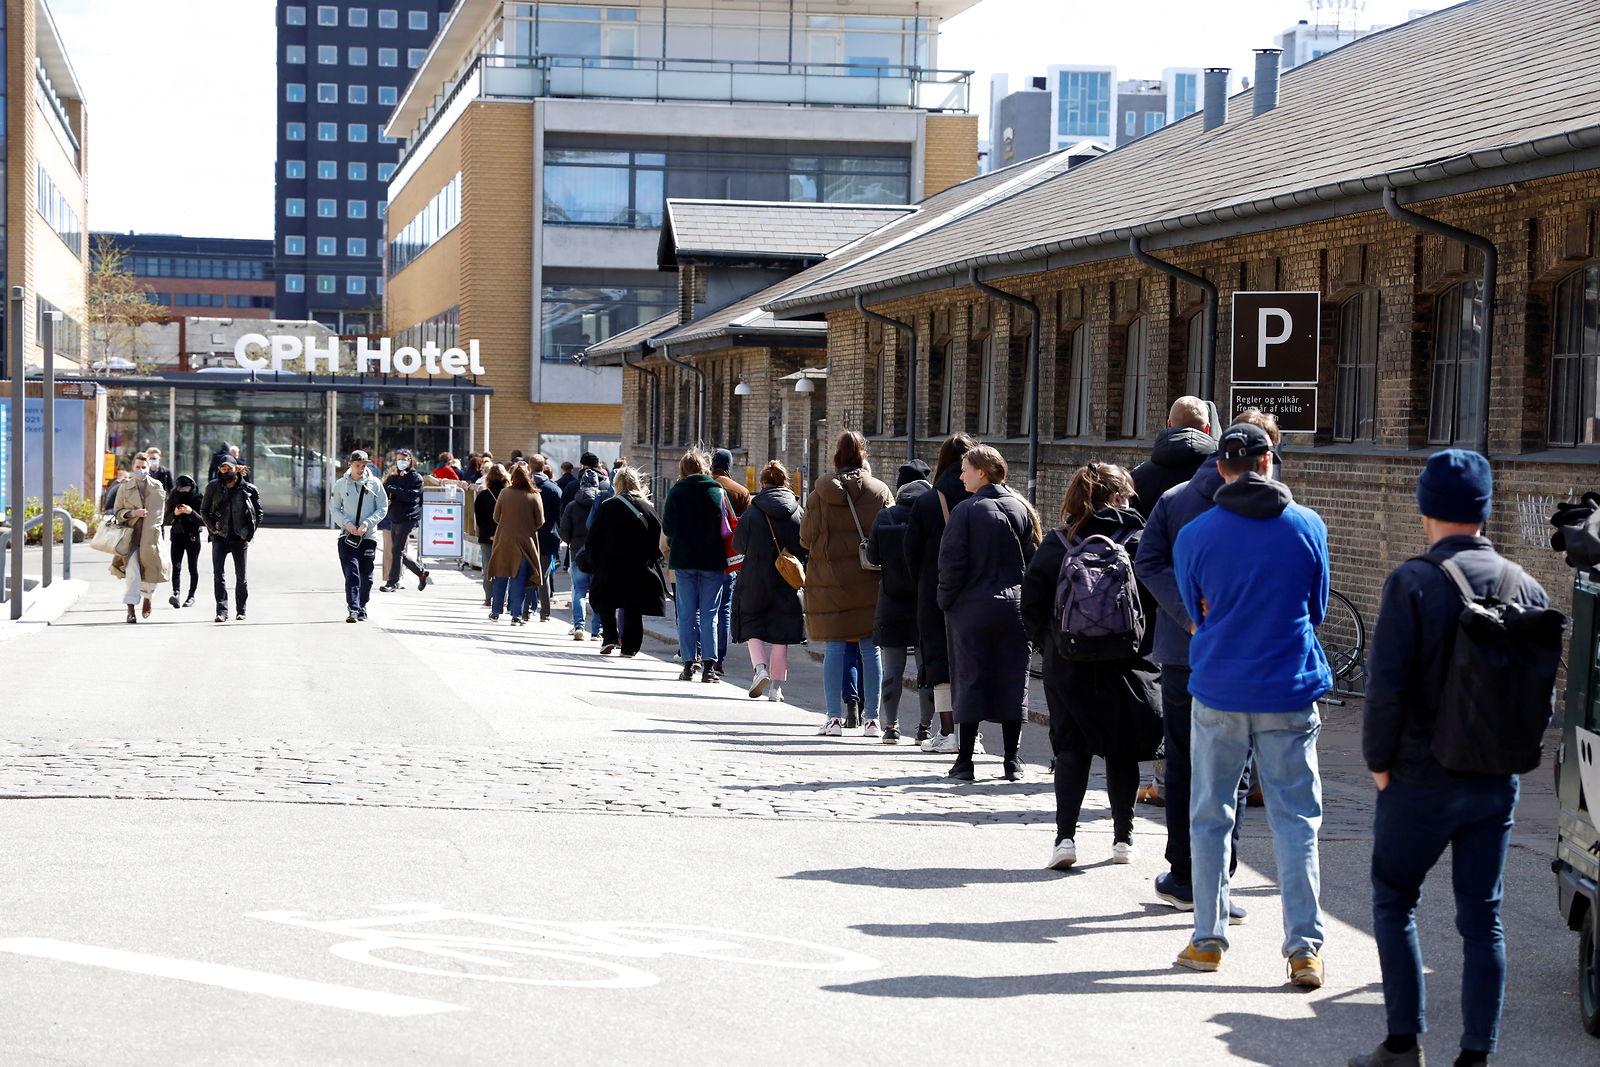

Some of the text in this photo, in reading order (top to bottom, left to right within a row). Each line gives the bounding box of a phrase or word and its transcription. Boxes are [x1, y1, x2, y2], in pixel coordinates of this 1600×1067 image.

[1257, 307, 1293, 368] P
[234, 333, 486, 375] CPH Hotel
[1236, 395, 1299, 405] Regler og vilkår
[1236, 404, 1302, 413] fremår af skilte
